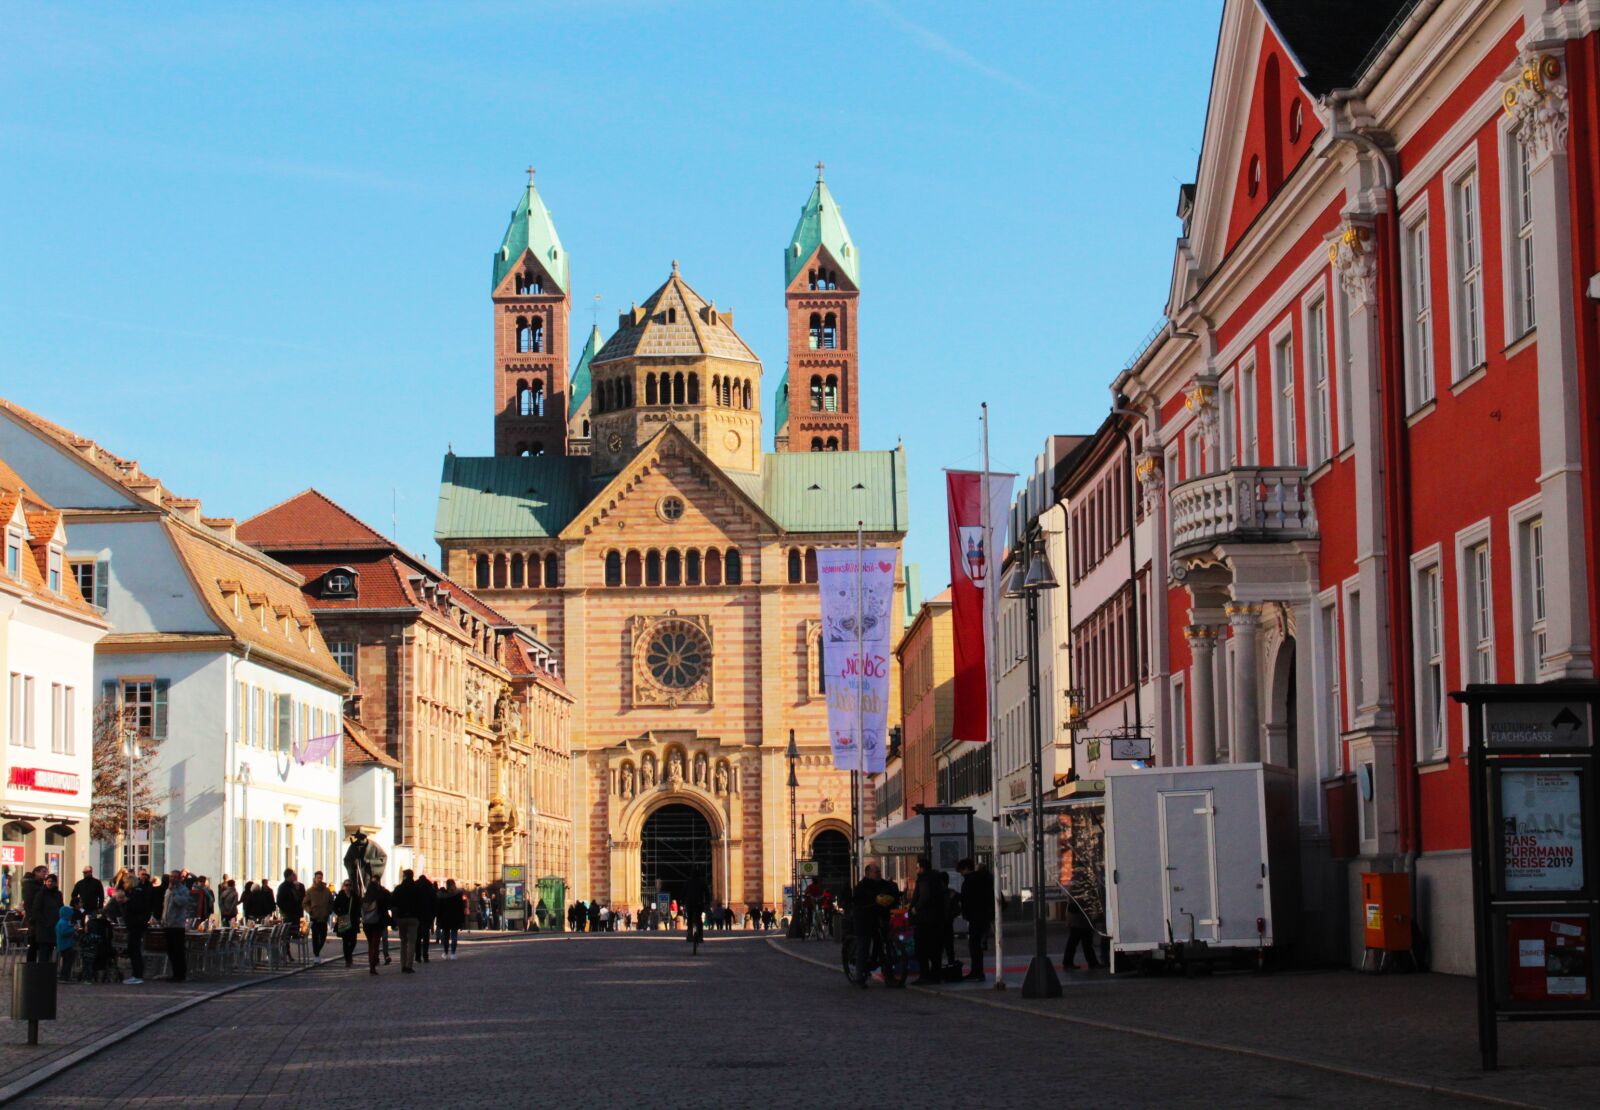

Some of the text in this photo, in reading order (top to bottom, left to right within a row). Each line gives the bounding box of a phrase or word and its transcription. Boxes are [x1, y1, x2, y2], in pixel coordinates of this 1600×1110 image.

[1504, 836, 1537, 847] HANS
[1504, 847, 1573, 857] PURRMANN
[1504, 858, 1573, 868] PREISE 2019
